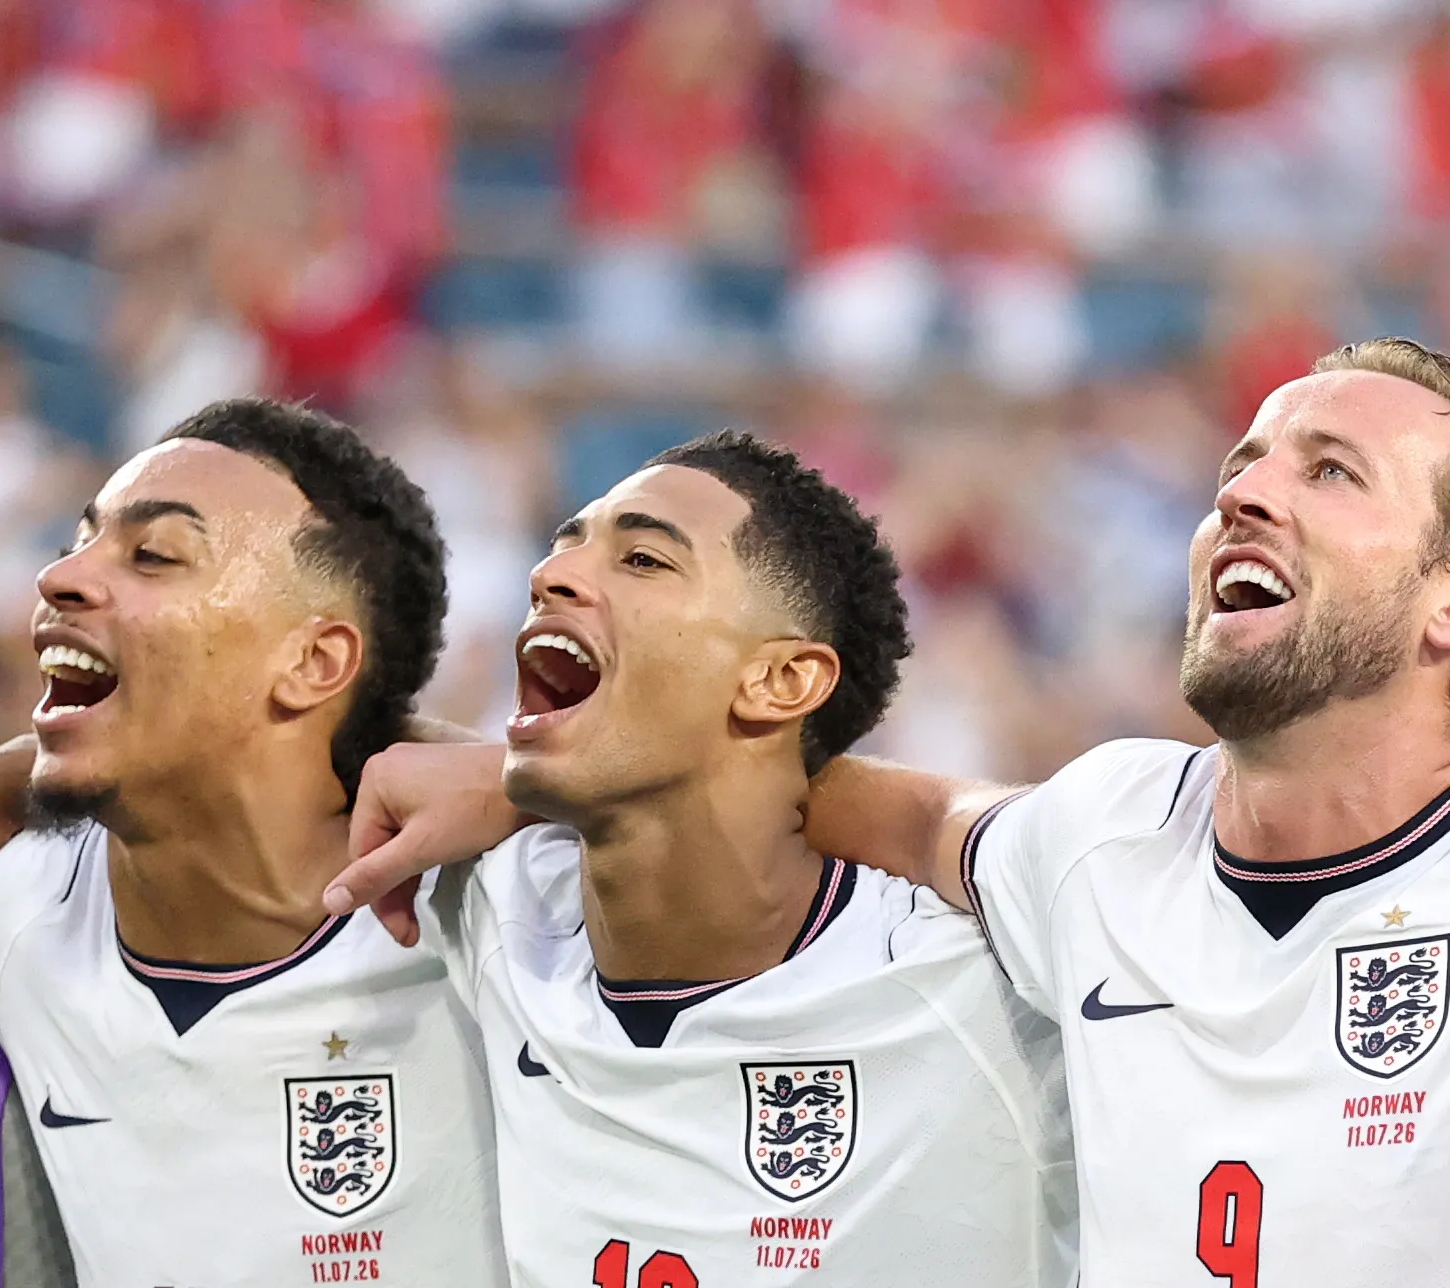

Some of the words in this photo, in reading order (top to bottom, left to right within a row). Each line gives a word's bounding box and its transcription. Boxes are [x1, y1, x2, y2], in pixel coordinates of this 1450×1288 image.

[1343, 1091, 1427, 1120] NORWAY
[1346, 1122, 1416, 1147] 11.07.26
[750, 1216, 833, 1240] NORWAY
[301, 1231, 384, 1256] NORWAY
[755, 1245, 821, 1269] 11.07.26
[311, 1258, 380, 1283] 11.07.26
